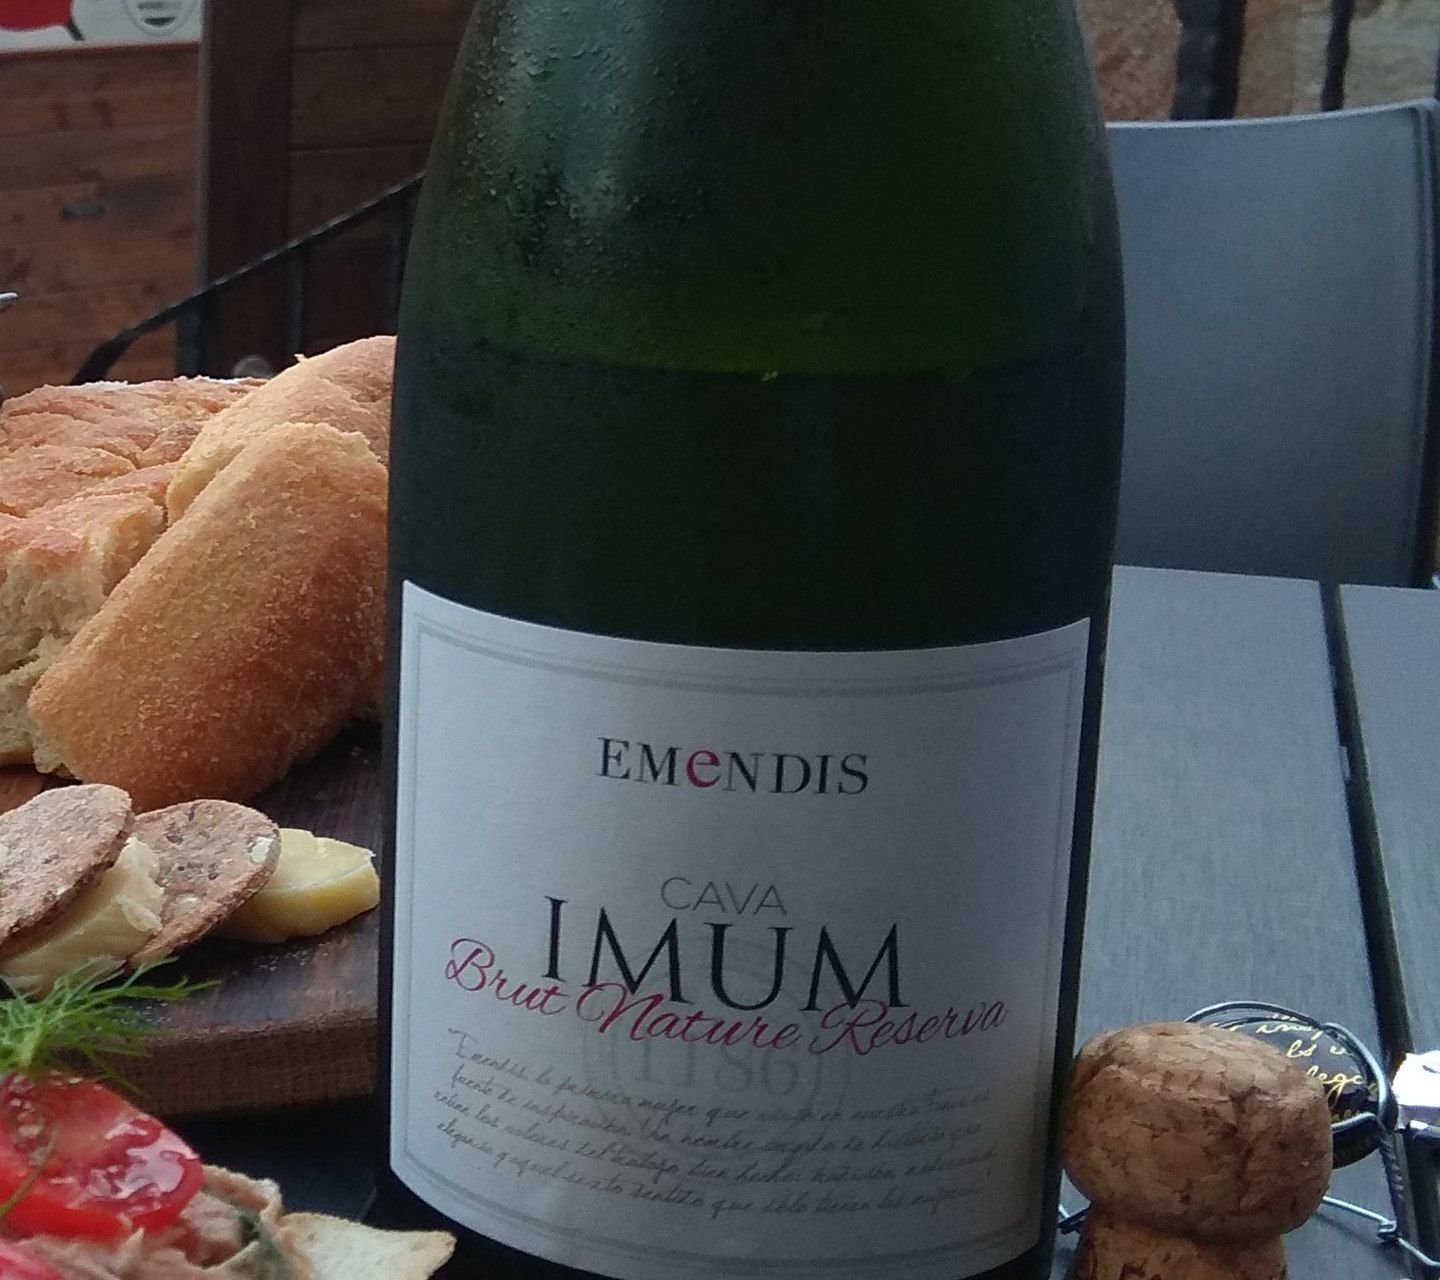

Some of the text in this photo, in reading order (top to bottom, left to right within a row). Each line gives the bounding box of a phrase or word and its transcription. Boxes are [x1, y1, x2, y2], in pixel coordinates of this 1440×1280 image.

[541, 895, 910, 1012] IMUM
[660, 876, 787, 916] CAVA
[444, 937, 1010, 1056] Brut Nature Reserva
